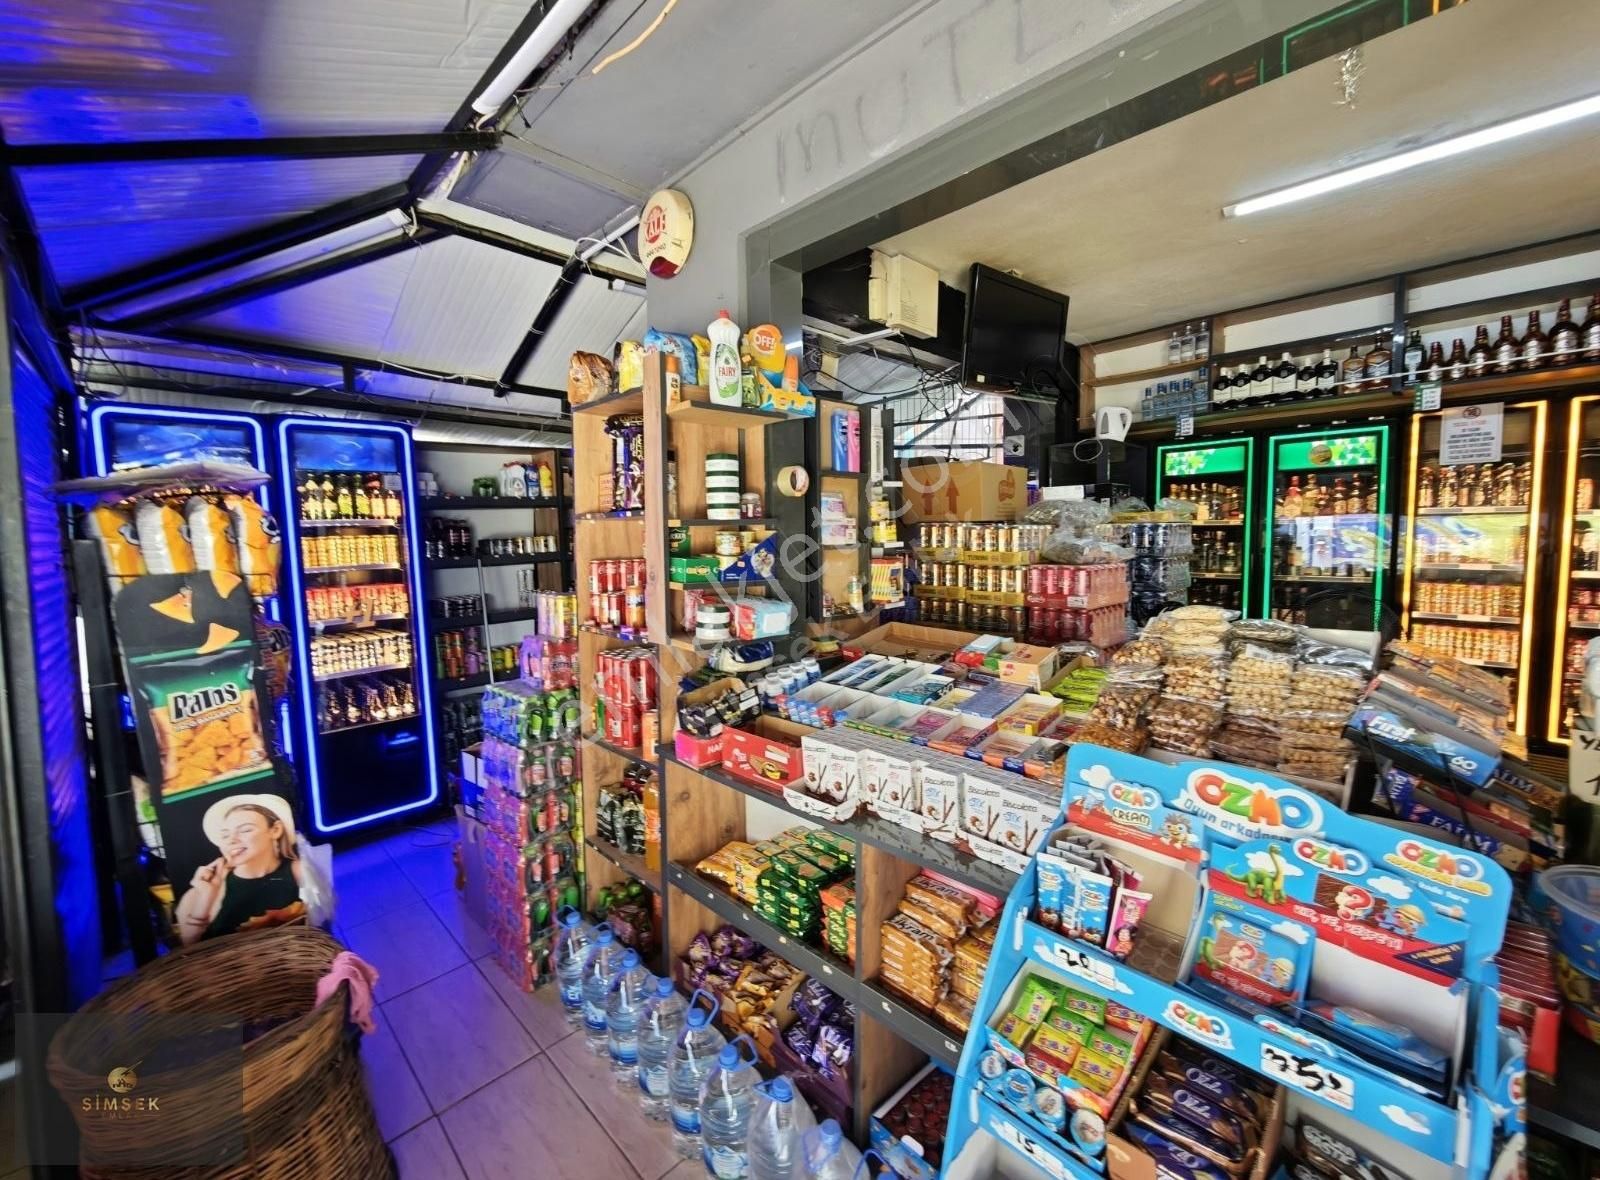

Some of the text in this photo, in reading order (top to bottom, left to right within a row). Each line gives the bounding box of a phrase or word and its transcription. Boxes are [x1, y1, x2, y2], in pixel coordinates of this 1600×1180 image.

[755, 333, 777, 350] OFF!
[718, 366, 736, 377] FAIRY
[1111, 784, 1157, 808] OZMO
[1195, 774, 1313, 829] OZMO
[1112, 807, 1151, 827] CREAM
[1297, 840, 1362, 874] OZMO
[1401, 842, 1479, 878] OZMO
[1173, 1003, 1225, 1036] OZMO
